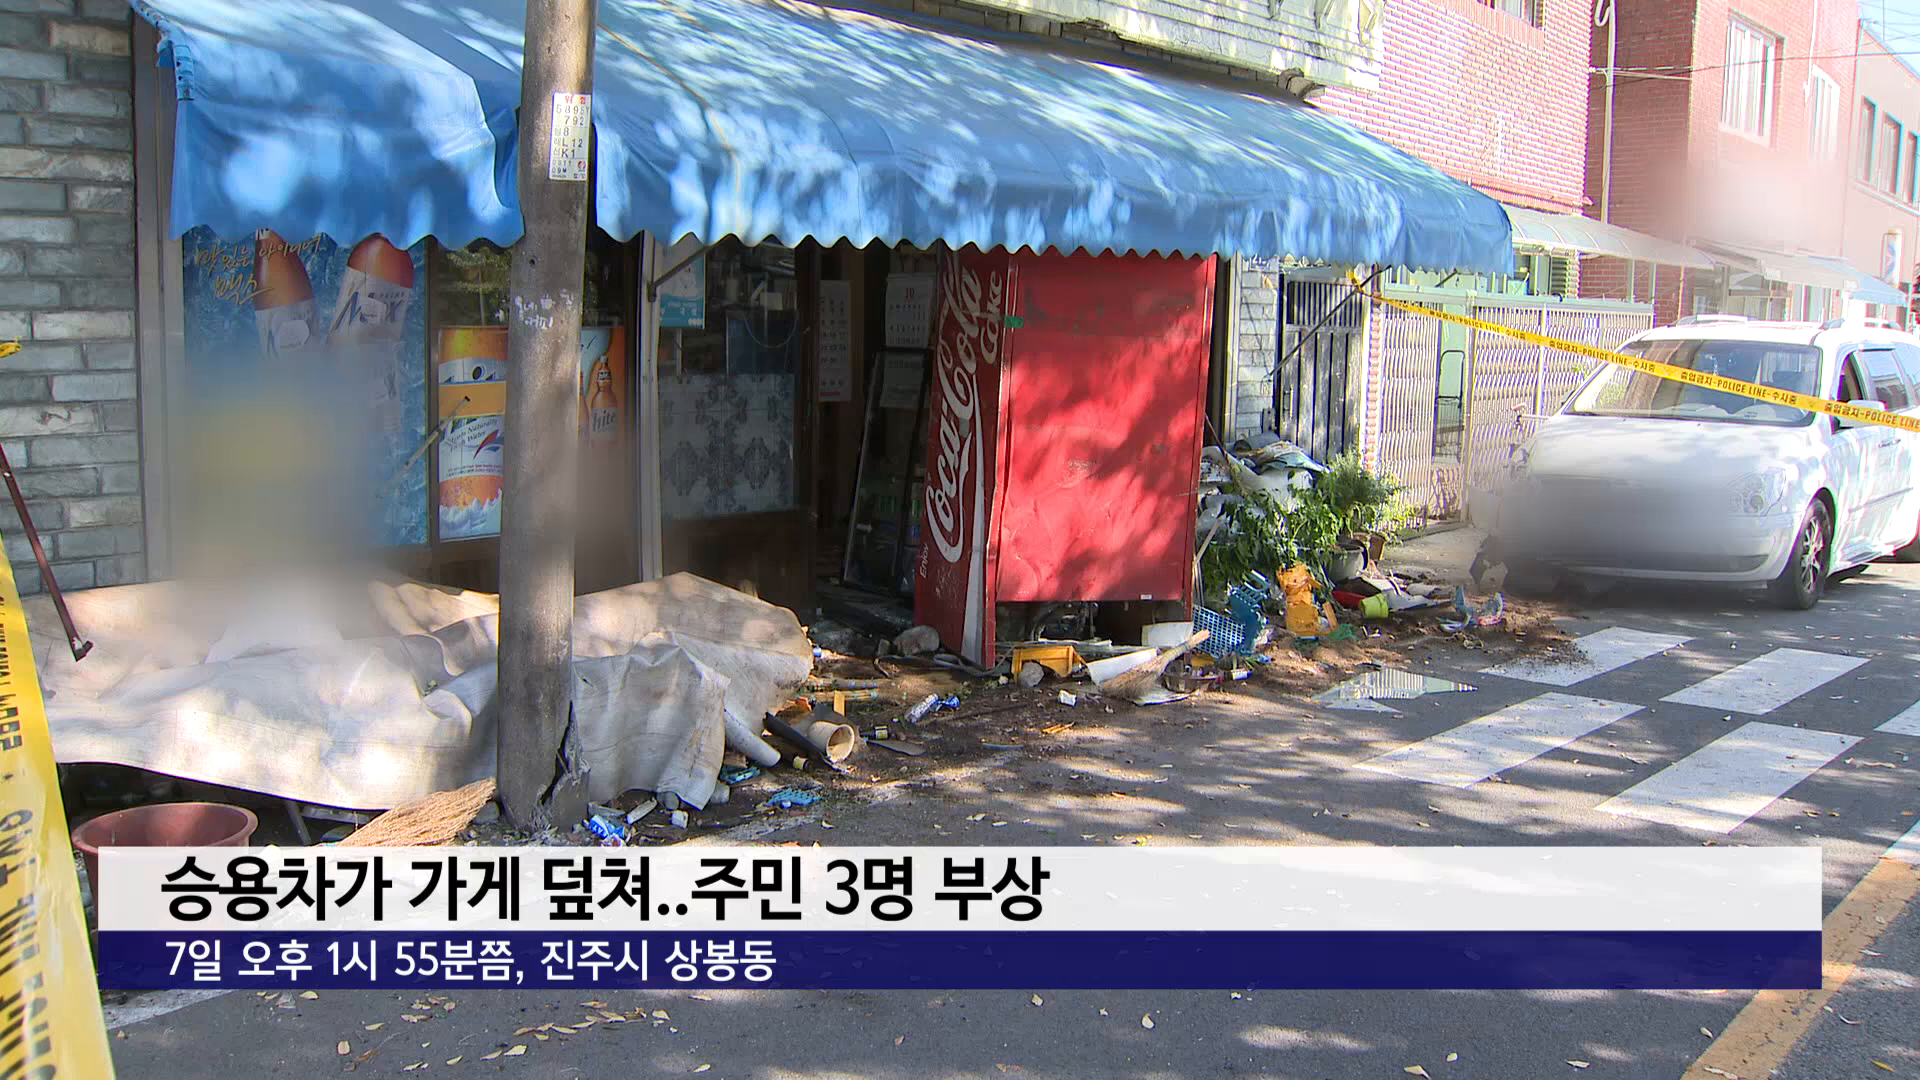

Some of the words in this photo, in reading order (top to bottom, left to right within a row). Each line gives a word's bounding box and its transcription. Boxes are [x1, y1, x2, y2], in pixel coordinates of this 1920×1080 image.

[980, 270, 1003, 365] Coke
[926, 248, 983, 563] Coca-Cola
[918, 542, 929, 579] Enjoy
